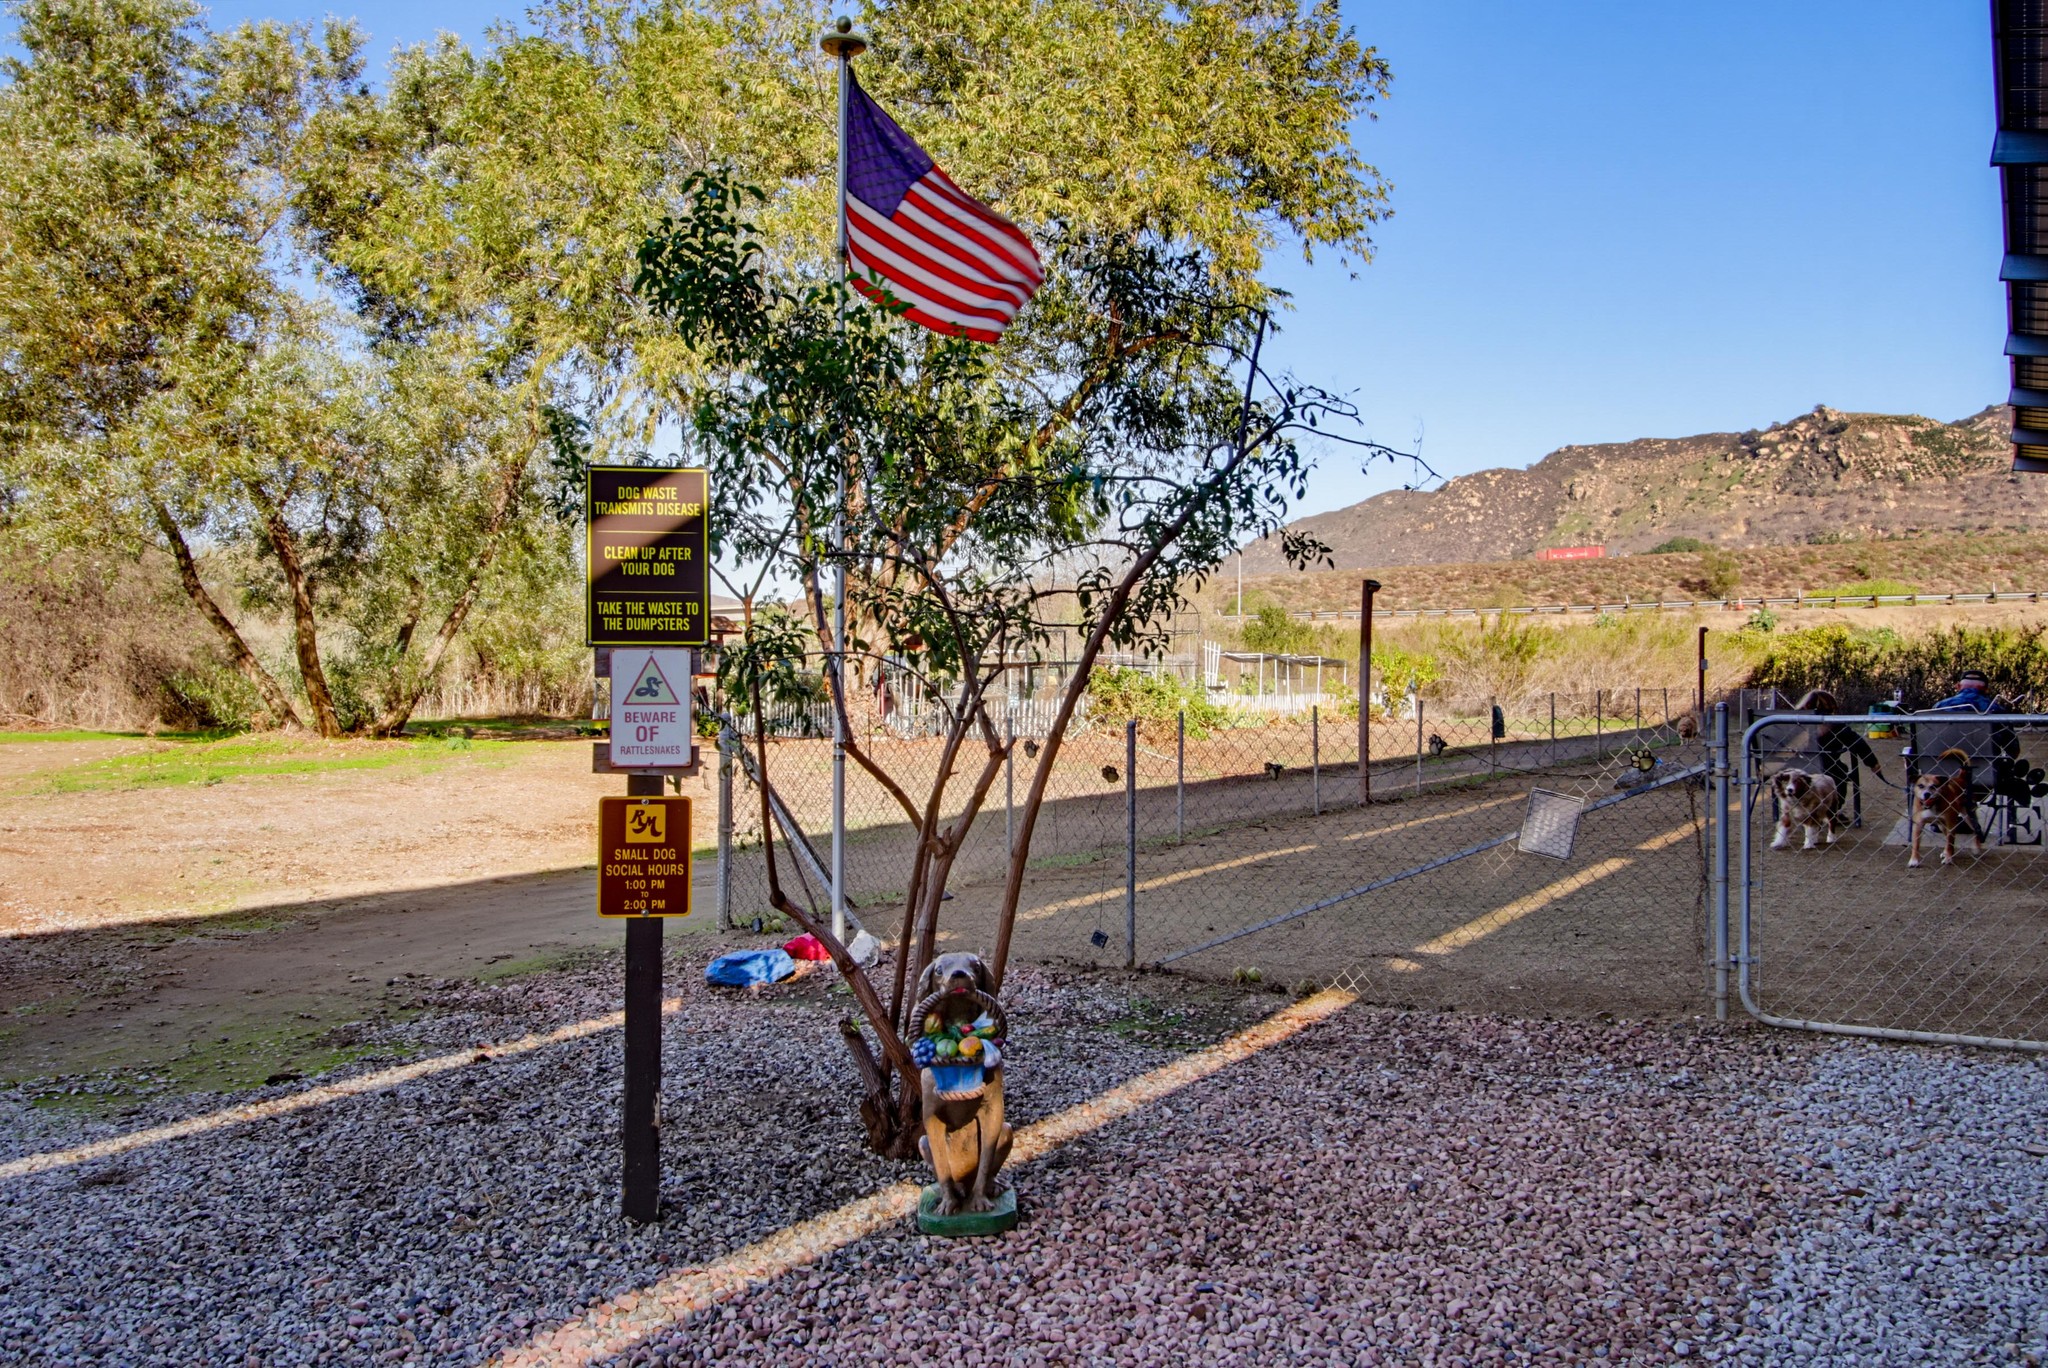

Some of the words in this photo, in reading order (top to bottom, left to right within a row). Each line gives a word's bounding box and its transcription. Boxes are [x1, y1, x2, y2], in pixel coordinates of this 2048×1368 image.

[618, 487, 640, 500] DOG
[643, 487, 677, 500] WASTE
[595, 502, 654, 515] TRANSMITS
[657, 503, 700, 516] DISEASE
[604, 546, 638, 559] CLEAN
[641, 547, 656, 560] UP
[659, 547, 692, 560] AFTER
[621, 563, 650, 575] YOUR
[653, 563, 675, 576] DOG
[597, 602, 622, 615] TAKE
[625, 602, 645, 615] THE
[648, 602, 682, 615] WASTE
[685, 602, 699, 616] TO
[603, 617, 623, 630] THE
[626, 617, 690, 631] DUMPSTERS
[624, 711, 676, 723] BEWARE
[636, 725, 659, 742] OF
[620, 745, 680, 755] RATTLESNAKES
[614, 849, 649, 860] SMALL
[653, 848, 676, 860] DOG
[606, 864, 643, 876] SOCIAL
[648, 864, 684, 876] HOURS
[625, 880, 646, 889] 1:00
[651, 880, 665, 889] PM
[623, 900, 646, 910] 2:00
[651, 900, 665, 909] PM
